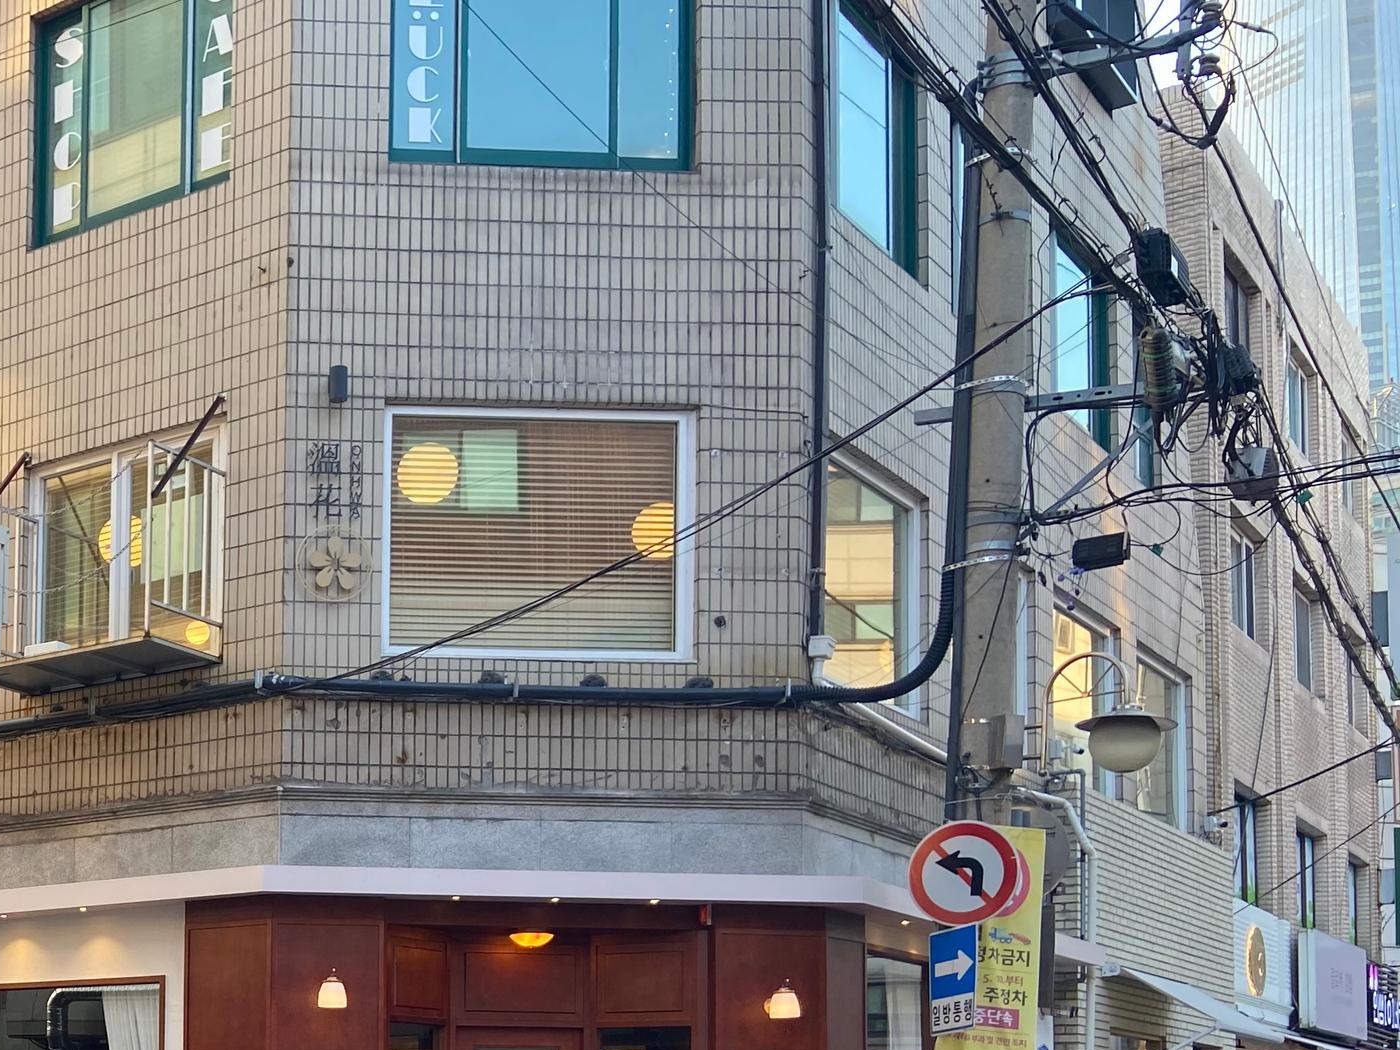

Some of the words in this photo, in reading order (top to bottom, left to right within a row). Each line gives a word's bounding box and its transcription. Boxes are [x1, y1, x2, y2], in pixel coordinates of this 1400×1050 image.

[200, 0, 234, 172] AFE
[407, 0, 444, 143] ÜCK
[350, 444, 363, 519] ONHWA
[932, 998, 973, 1027] 일방통행
[983, 986, 1028, 1006] 주정차
